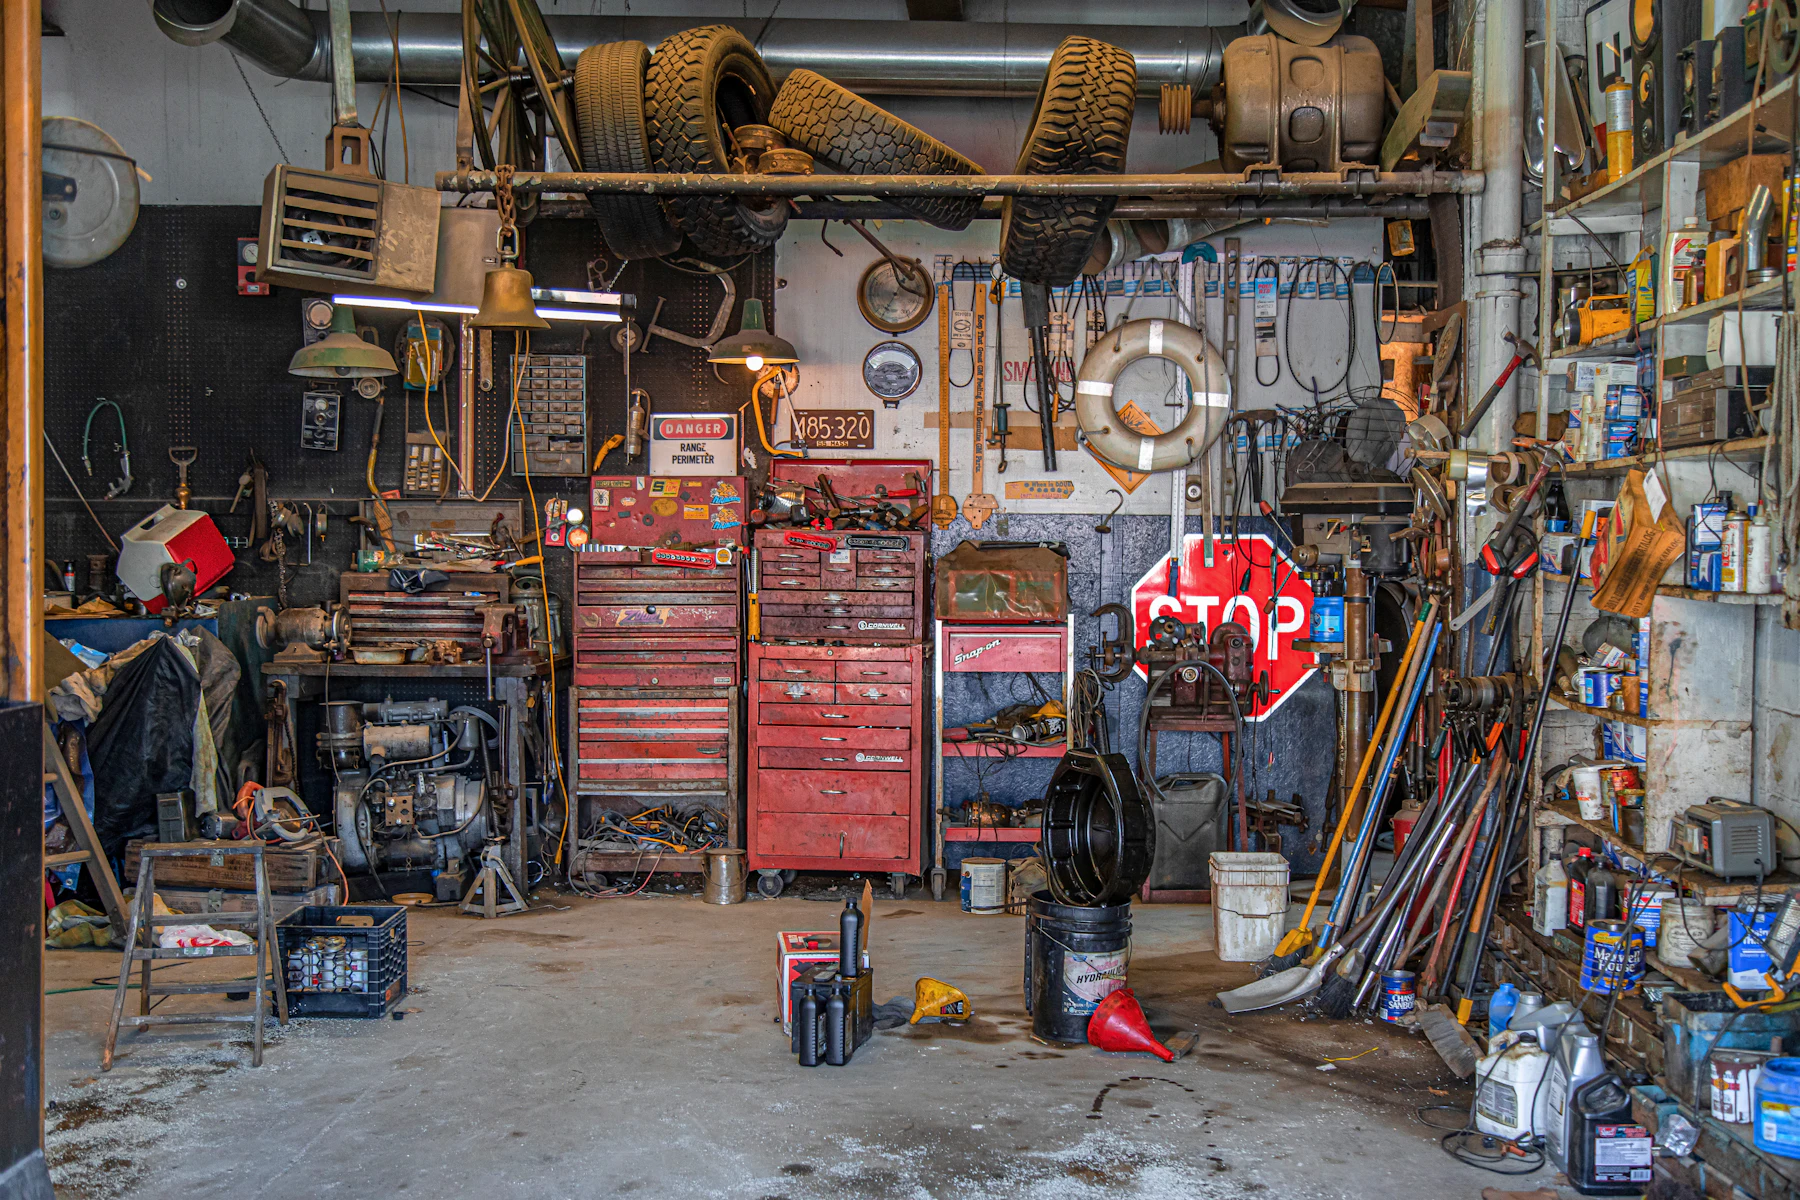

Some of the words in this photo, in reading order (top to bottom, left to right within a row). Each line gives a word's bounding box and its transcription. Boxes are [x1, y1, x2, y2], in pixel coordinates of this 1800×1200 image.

[975, 314, 985, 330] Keep
[976, 331, 984, 345] That
[976, 347, 984, 363] Great
[976, 365, 984, 376] GM
[975, 378, 984, 399] Feeling
[976, 401, 984, 416] With
[665, 423, 721, 434] DANGER
[975, 417, 983, 441] Genuine
[680, 443, 706, 452] RANGE
[975, 443, 983, 454] GM
[672, 454, 715, 465] PERIMETER
[1126, 470, 1133, 482] 1
[1636, 528, 1656, 561] CATALOG
[1659, 537, 1681, 564] CATALOG
[1594, 946, 1641, 963] Maxwell
[1598, 959, 1636, 972] House
[1076, 964, 1122, 984] HYDRAULIC
